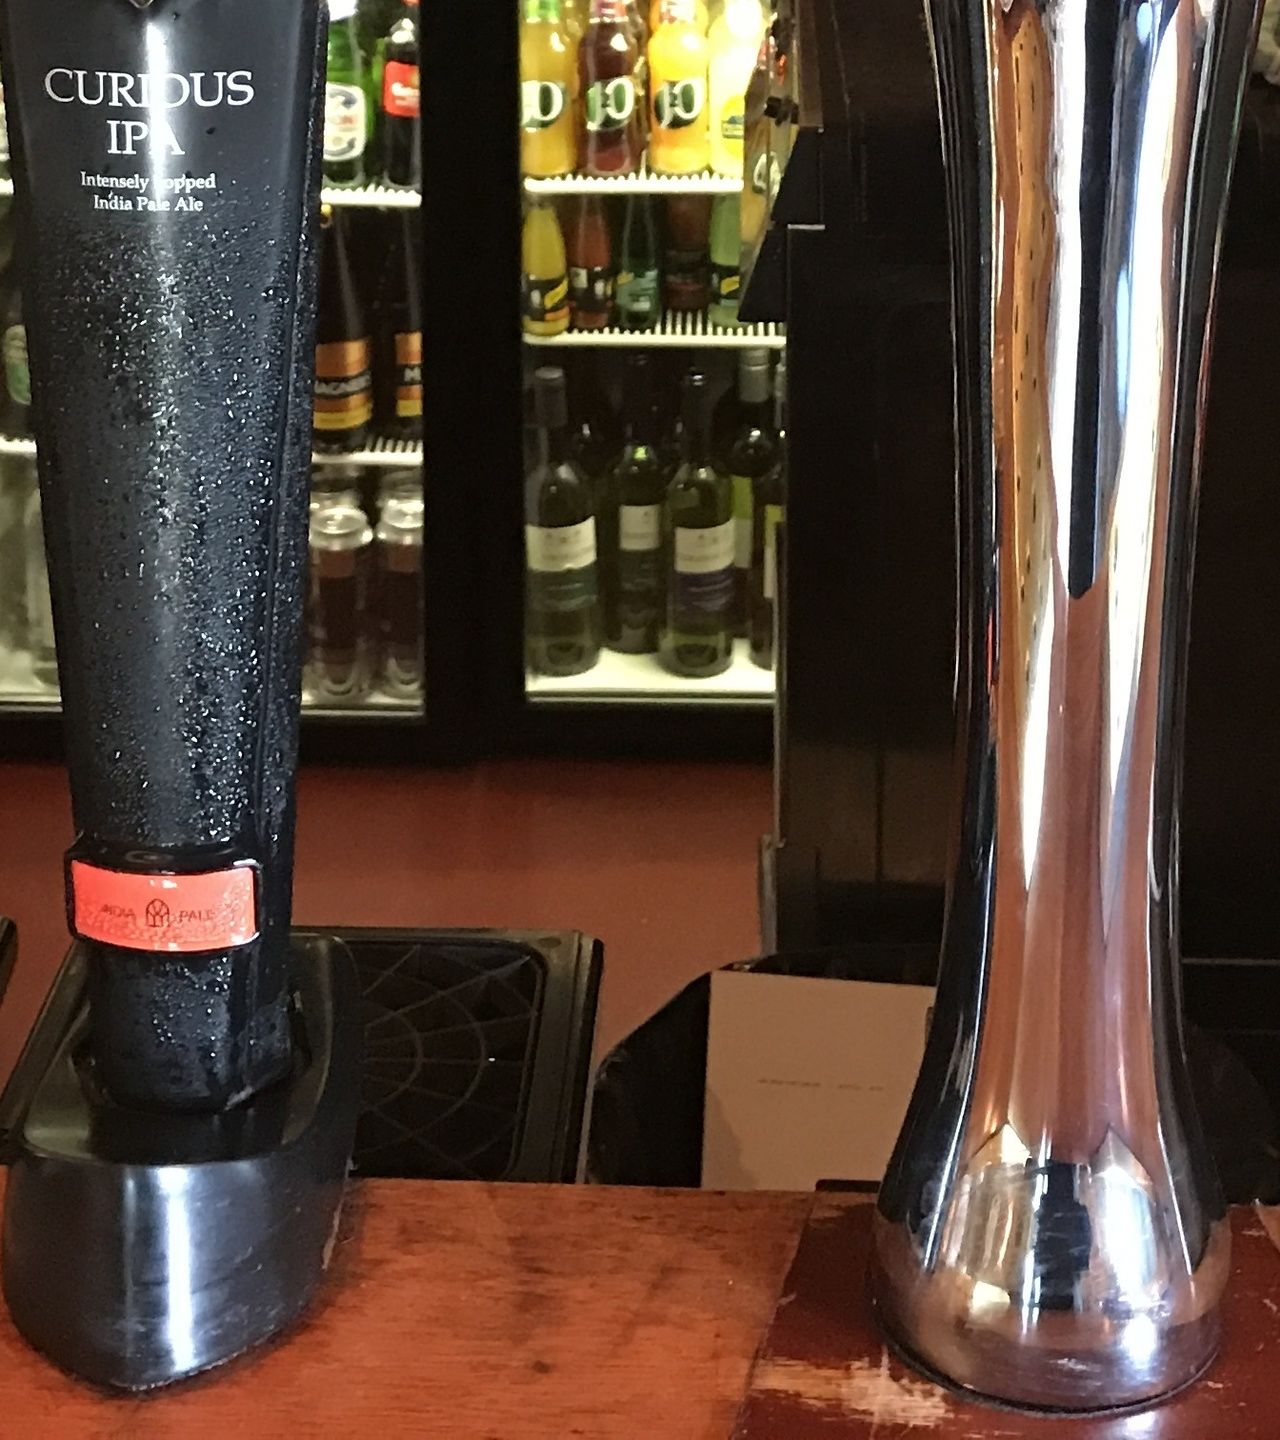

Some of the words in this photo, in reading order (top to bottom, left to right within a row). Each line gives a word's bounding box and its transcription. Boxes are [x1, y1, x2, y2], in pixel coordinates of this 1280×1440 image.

[43, 66, 256, 109] CURIOUS
[106, 119, 186, 157] IPA
[80, 171, 150, 192] Intensely
[153, 172, 217, 192] opped
[93, 191, 134, 212] India
[136, 195, 171, 212] Pale
[174, 195, 205, 213] Ale
[179, 908, 217, 923] PALE
